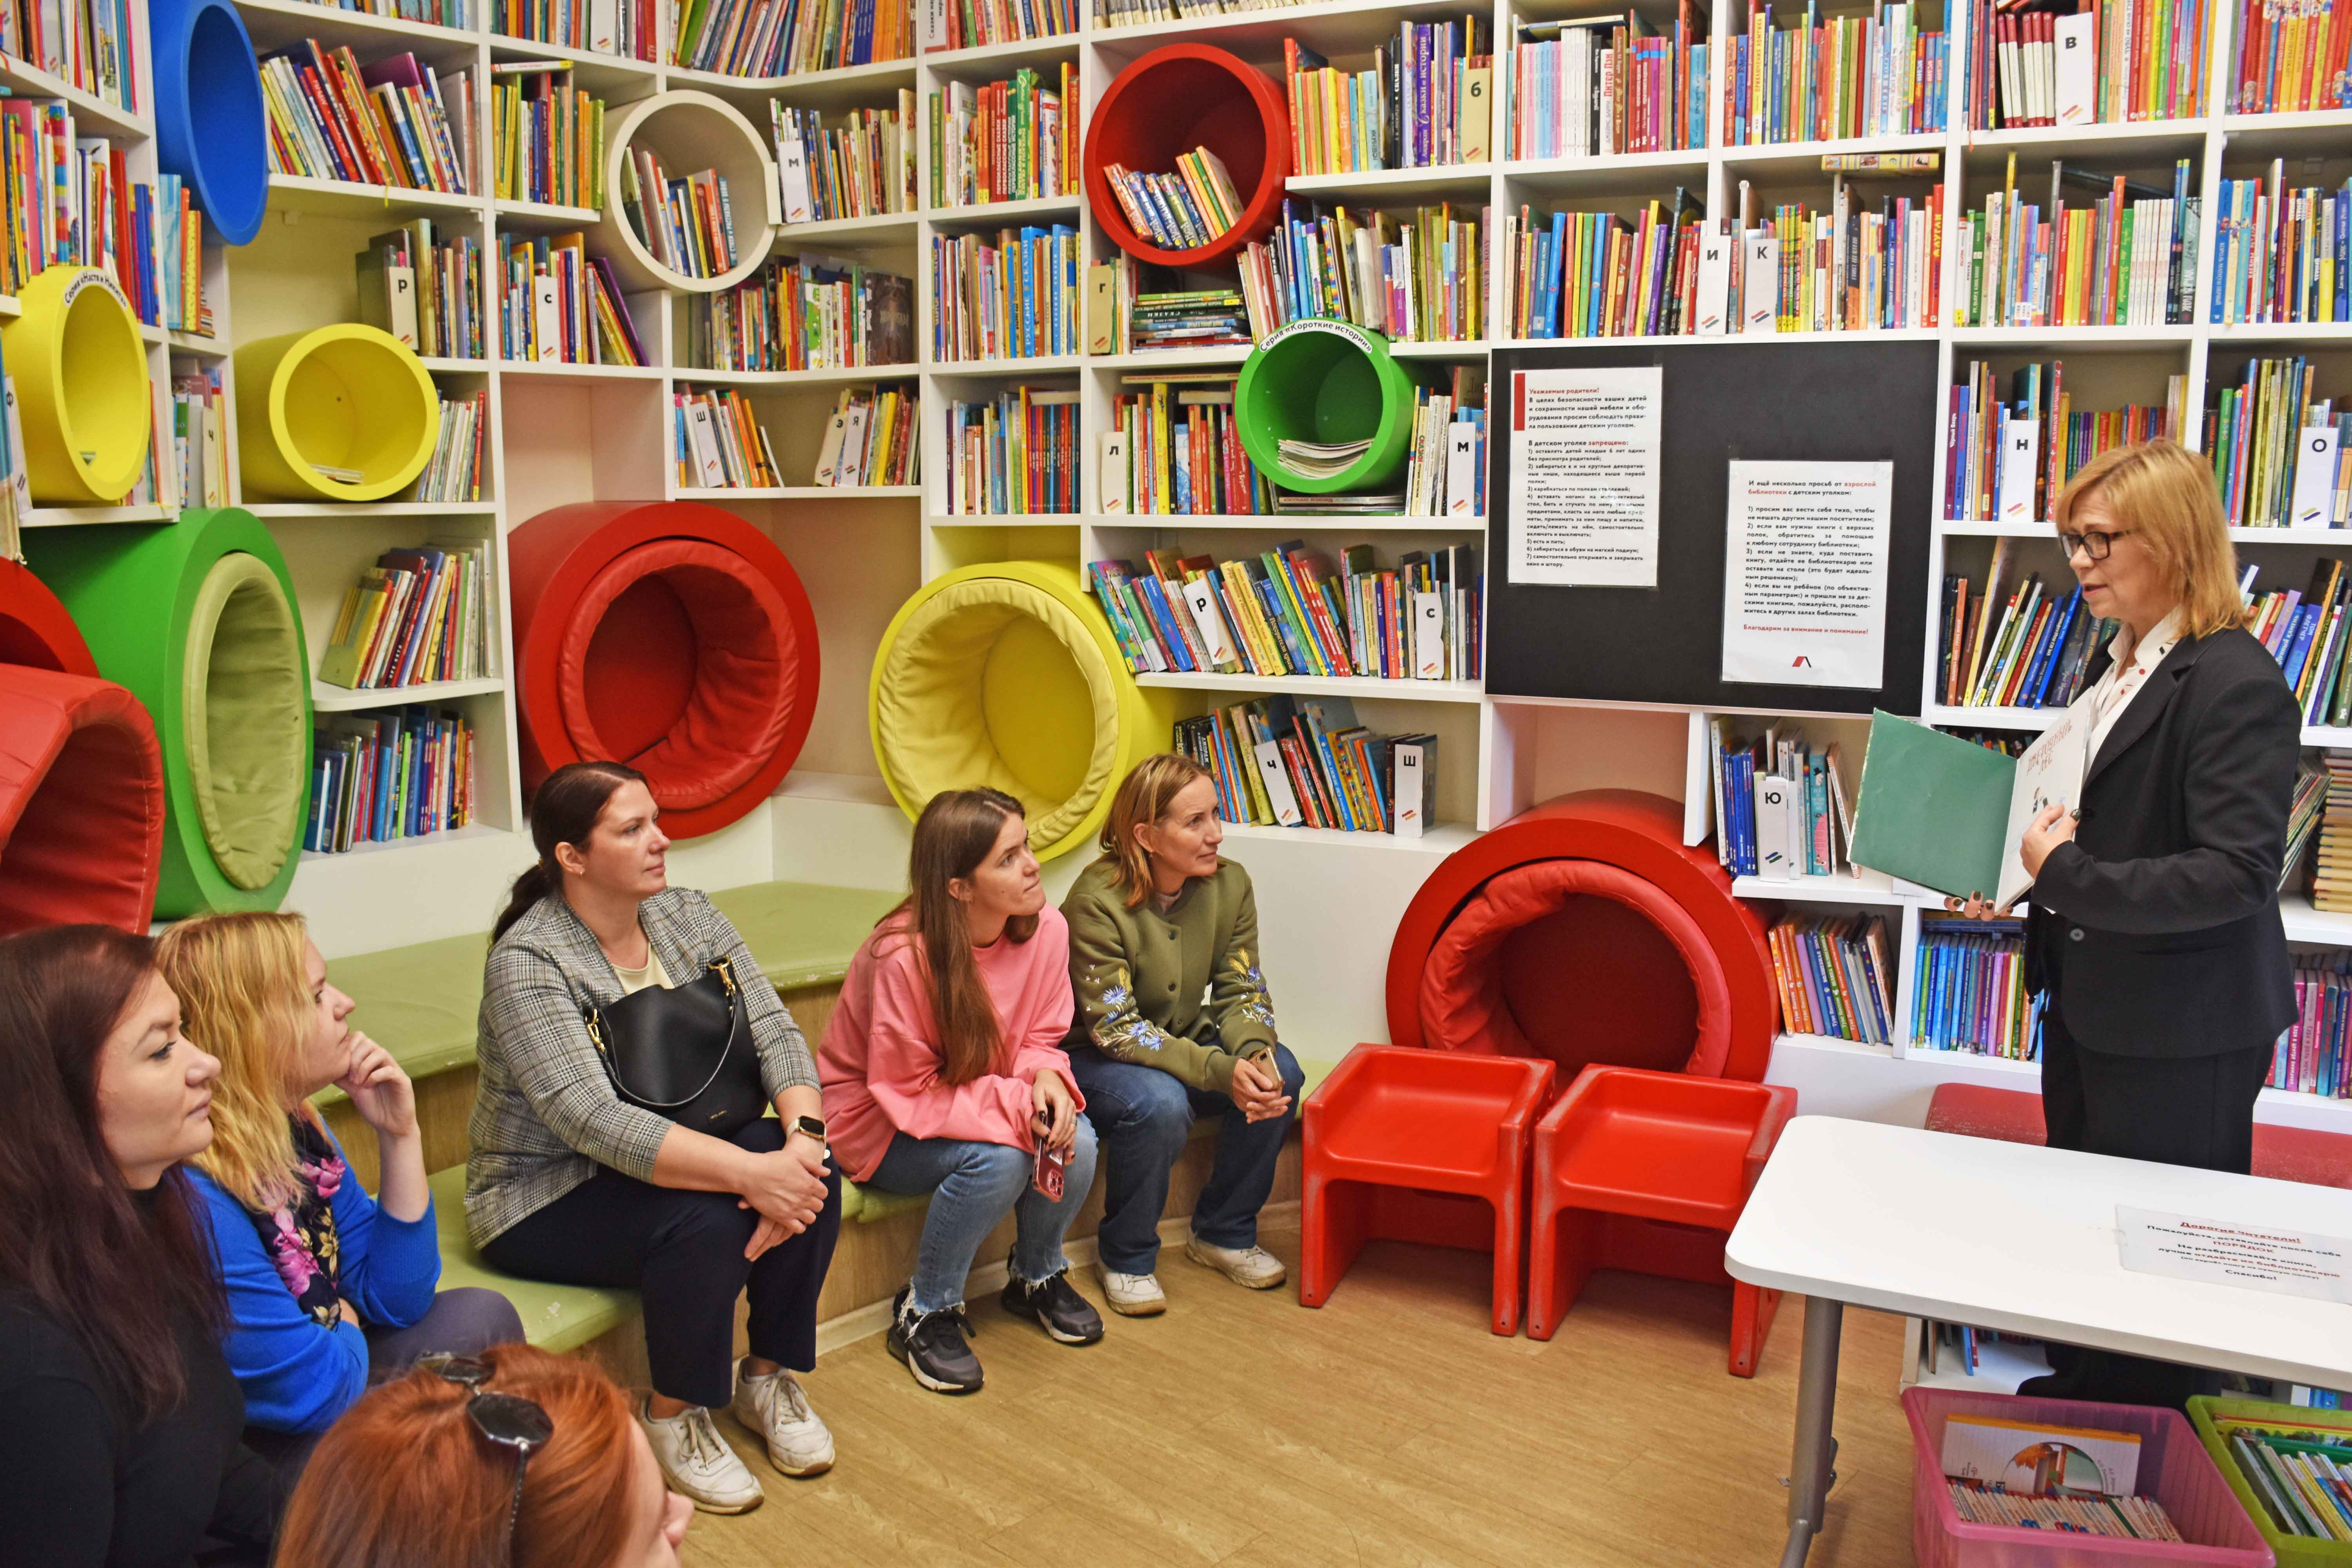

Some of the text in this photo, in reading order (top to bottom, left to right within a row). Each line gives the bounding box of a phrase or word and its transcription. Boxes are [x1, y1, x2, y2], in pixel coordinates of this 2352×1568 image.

[1420, 37, 1429, 79] истории
[1418, 82, 1430, 124] Сказки
[1933, 214, 1942, 258] МАУГЛИ
[65, 280, 80, 303] Серия
[1260, 322, 1372, 351] Серия «Короткие истории»
[2298, 614, 2312, 641] ФЛЕТЧЕР
[2308, 623, 2316, 635] ТОМ
[1269, 617, 1294, 670] Покорители крыш
[2147, 1225, 2214, 1239] Пожалуйста,
[2217, 1237, 2278, 1248] оставляйте
[2180, 1221, 2302, 1243] Дорогие читатели!
[2195, 1246, 2278, 1261] разбрасывайте
[2280, 1259, 2317, 1268] книги,
[2213, 1241, 2275, 1254] ПОРЯДОК
[2194, 1253, 2238, 1261] отдайте
[2256, 1261, 2341, 1278] библиотекарю
[2225, 1269, 2278, 1281] Спасибо!
